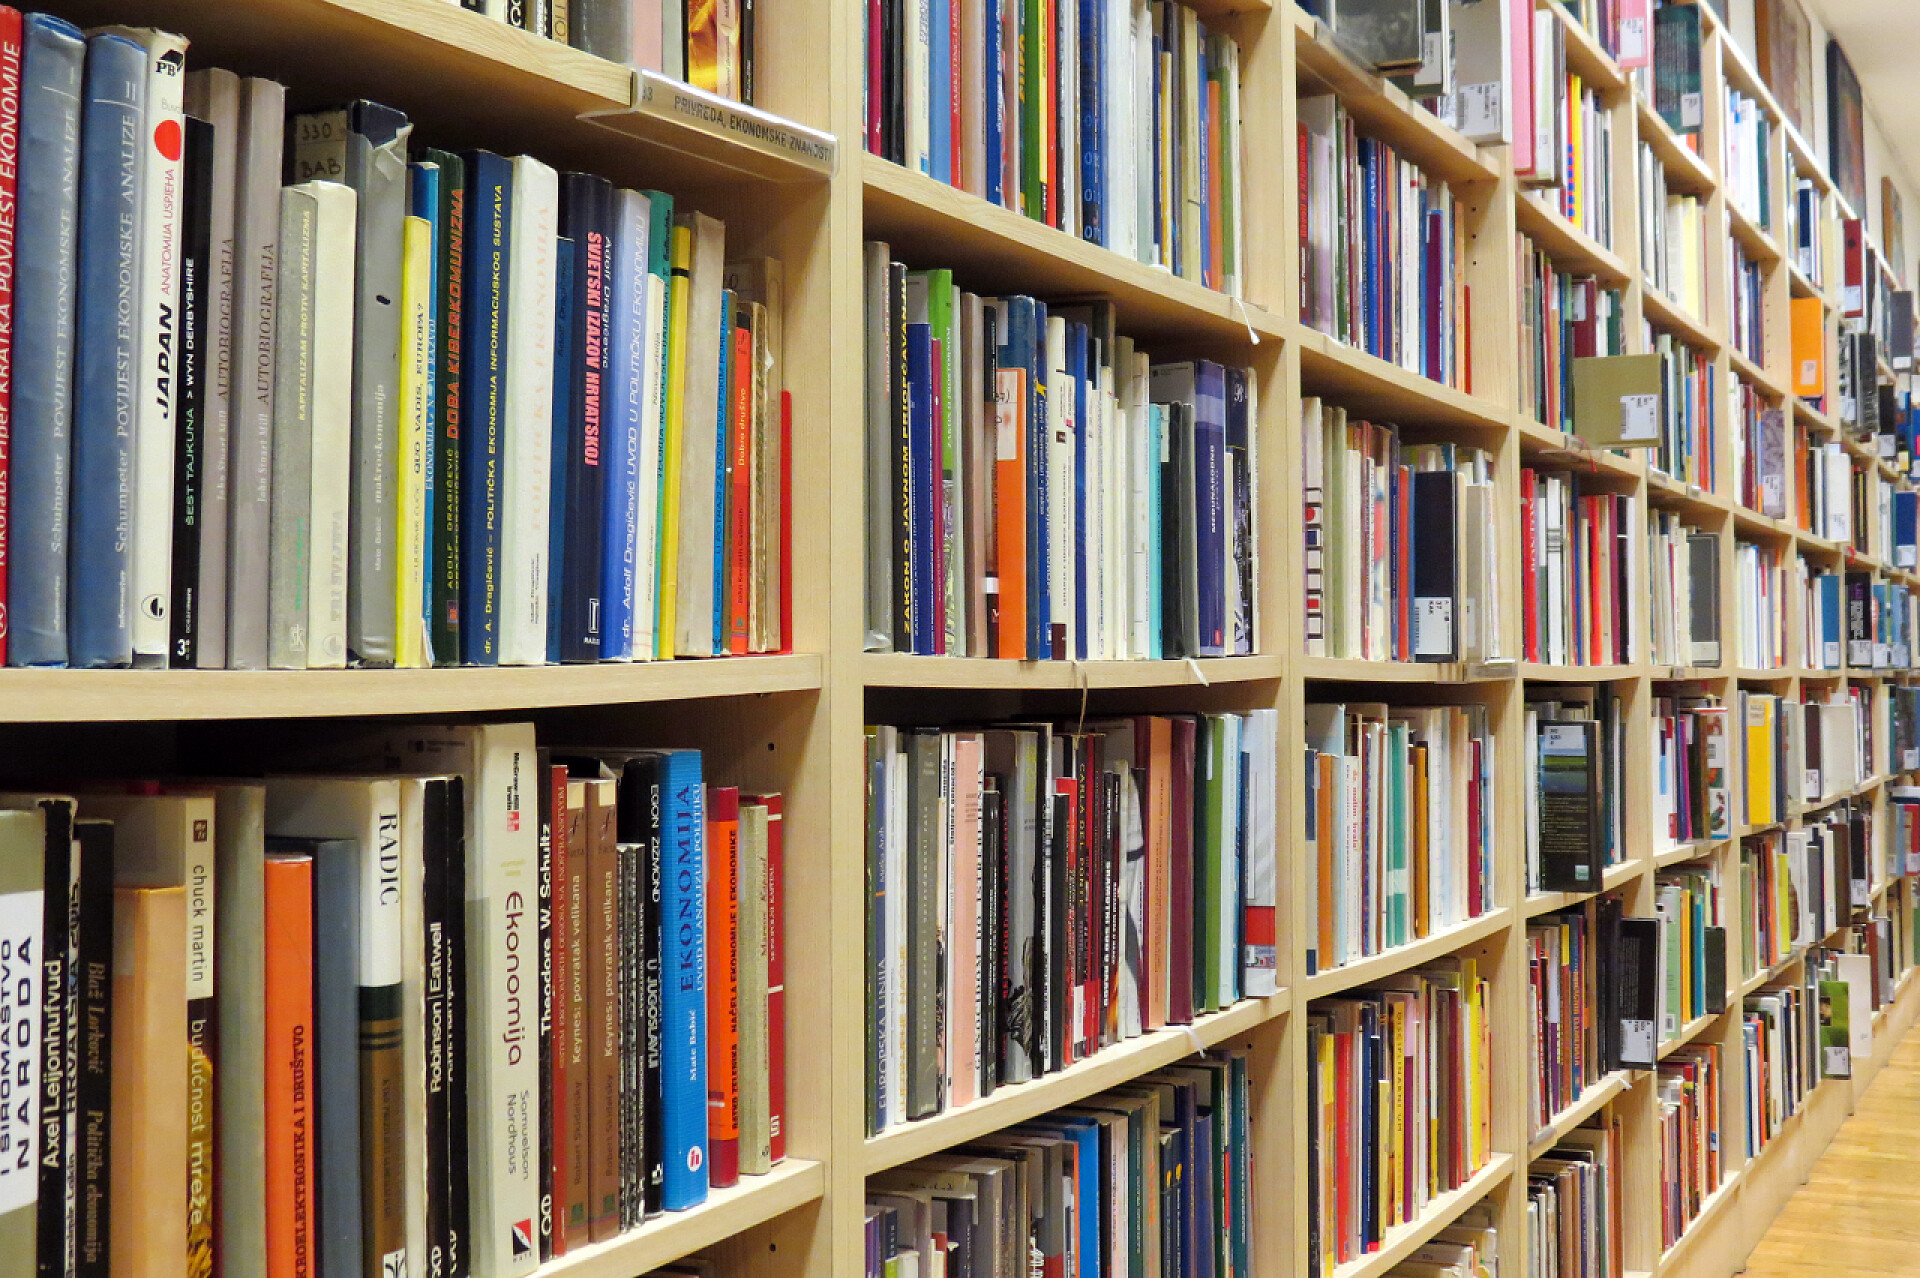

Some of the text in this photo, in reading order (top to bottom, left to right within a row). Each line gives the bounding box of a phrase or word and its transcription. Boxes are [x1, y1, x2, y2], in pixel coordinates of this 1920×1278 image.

[0, 41, 20, 293] POVIJEST EKONOMIJE
[61, 108, 76, 202] ANALIZE
[120, 115, 136, 204] ANALIZE
[300, 159, 342, 178] BAB
[729, 114, 787, 148] EKONOMSKE
[300, 210, 312, 290] KAPITALIZMA
[493, 184, 503, 247] SUSTAVA
[56, 208, 72, 339] EKONOMSKE
[118, 212, 133, 340] EKONOMSKE
[156, 168, 175, 420] JAPAN ANATOMIJA USPJEHA
[185, 258, 195, 351] DERBYSHIRE
[217, 238, 232, 401] AUTOBIOGRAFIJA
[299, 294, 309, 337] PROTIV
[448, 189, 463, 375] KIBERKOMUNIZMA
[490, 251, 501, 372] INFORMACIJSKOG
[185, 354, 195, 387] WYN
[257, 243, 274, 406] AUTOBIOGRAFIJA
[586, 231, 602, 466] SVJETSKI IZAZOV HRVATSKOJ
[52, 345, 67, 438] POVIJEST
[116, 346, 131, 438] POVIJEST
[446, 382, 460, 440] DOBA
[487, 375, 498, 455] EKONOMIJA
[622, 215, 646, 639] dr. Adolf Dragičević UVOD U POLITIČKU EKONOMIJU
[184, 408, 195, 482] TAJKUNA
[414, 441, 422, 474] QUO
[901, 445, 910, 532] JAVNOM
[114, 449, 129, 553] Schumpeter
[485, 459, 497, 531] POLITIČKA
[903, 539, 910, 555] O
[903, 560, 911, 635] ZAKON
[692, 783, 703, 852] POLITIKU
[676, 785, 695, 992] EKONOMIJA
[693, 863, 704, 930] ANALIZU
[729, 829, 737, 903] EKONOMIKE
[192, 864, 208, 982] chuck martin
[539, 823, 552, 1037] Theodore W. Schultz
[571, 875, 584, 1064] Keynes: povratak velikana
[604, 871, 616, 1057] Keynes: povratak velikana
[694, 946, 704, 992] UVOD
[729, 911, 738, 983] EKONOMIJE
[429, 921, 442, 1093] Robinson Eatwell
[503, 890, 526, 1066] Ekonomija
[647, 976, 659, 1069] JUGOSLAVIJI
[17, 936, 32, 1170] NARODA
[42, 959, 64, 1168] Axel Leijonhufvud
[288, 1024, 305, 1102] DRUŠTVO
[689, 1007, 698, 1081] Mate Babić
[878, 957, 888, 1109] EUROPSKA UNIJA
[190, 1018, 208, 1224] budućnost mreže
[507, 1094, 518, 1176] Nordhaus
[518, 1089, 530, 1181] Samuelson
